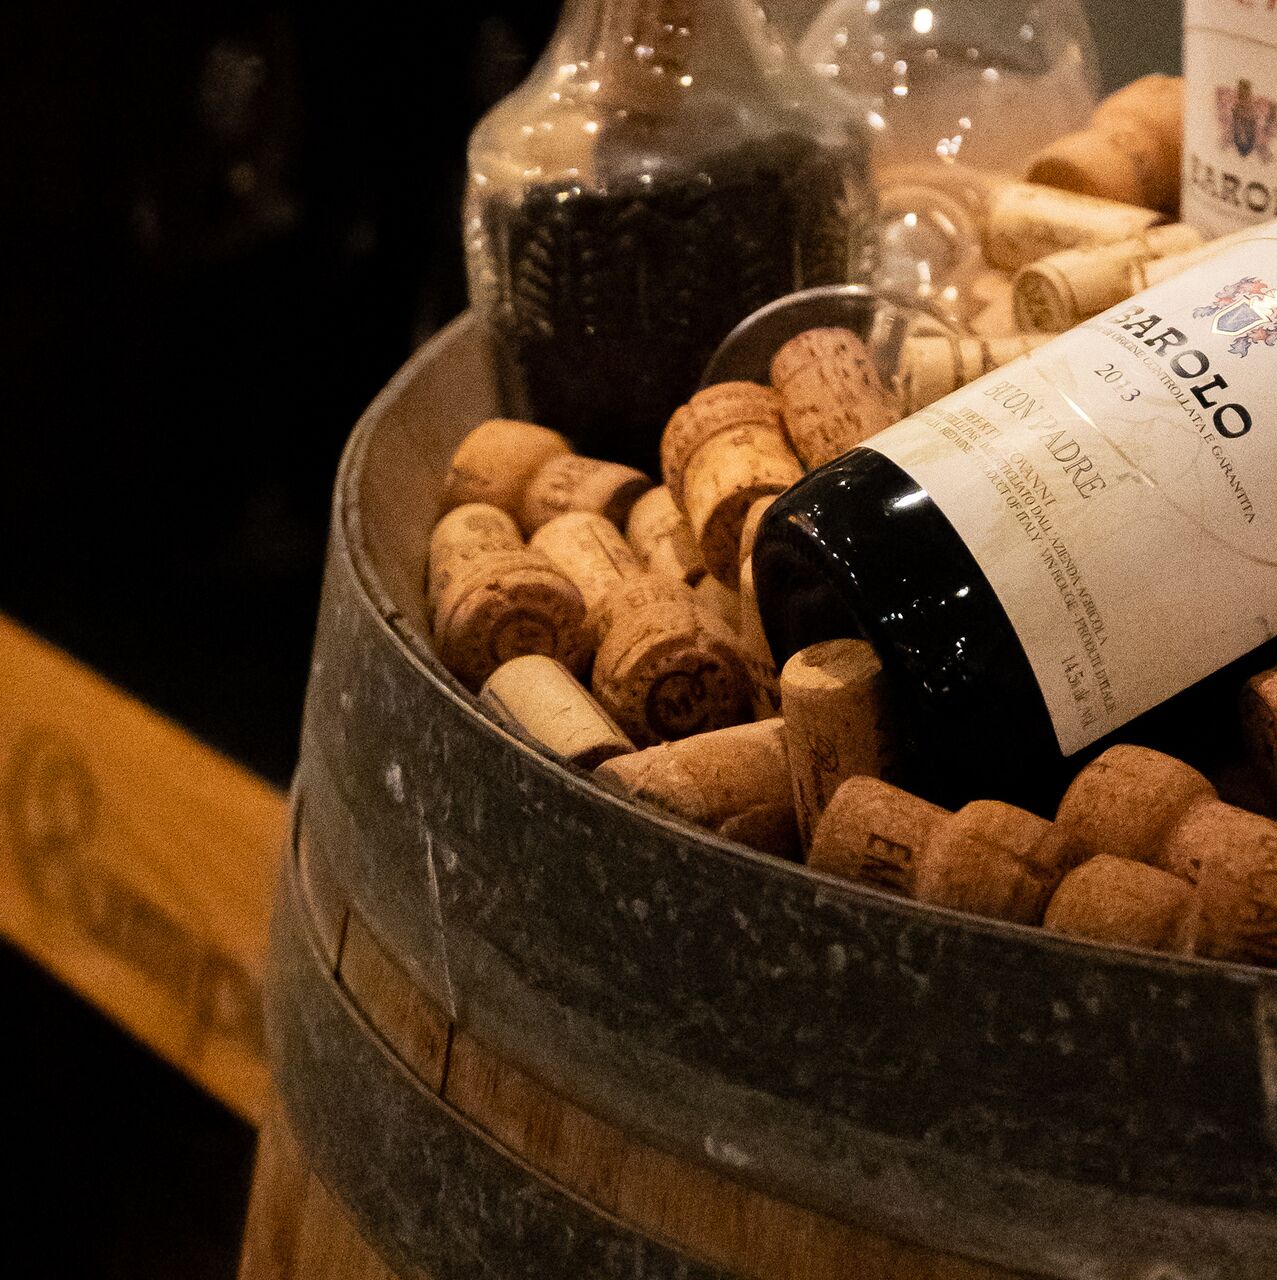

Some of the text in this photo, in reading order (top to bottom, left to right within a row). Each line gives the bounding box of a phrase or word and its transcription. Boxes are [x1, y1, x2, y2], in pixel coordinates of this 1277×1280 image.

[1094, 363, 1141, 403] 2013
[1105, 304, 1253, 439] BAROLO
[984, 380, 1107, 500] BUON PADRE
[1211, 444, 1256, 524] GARANTITA
